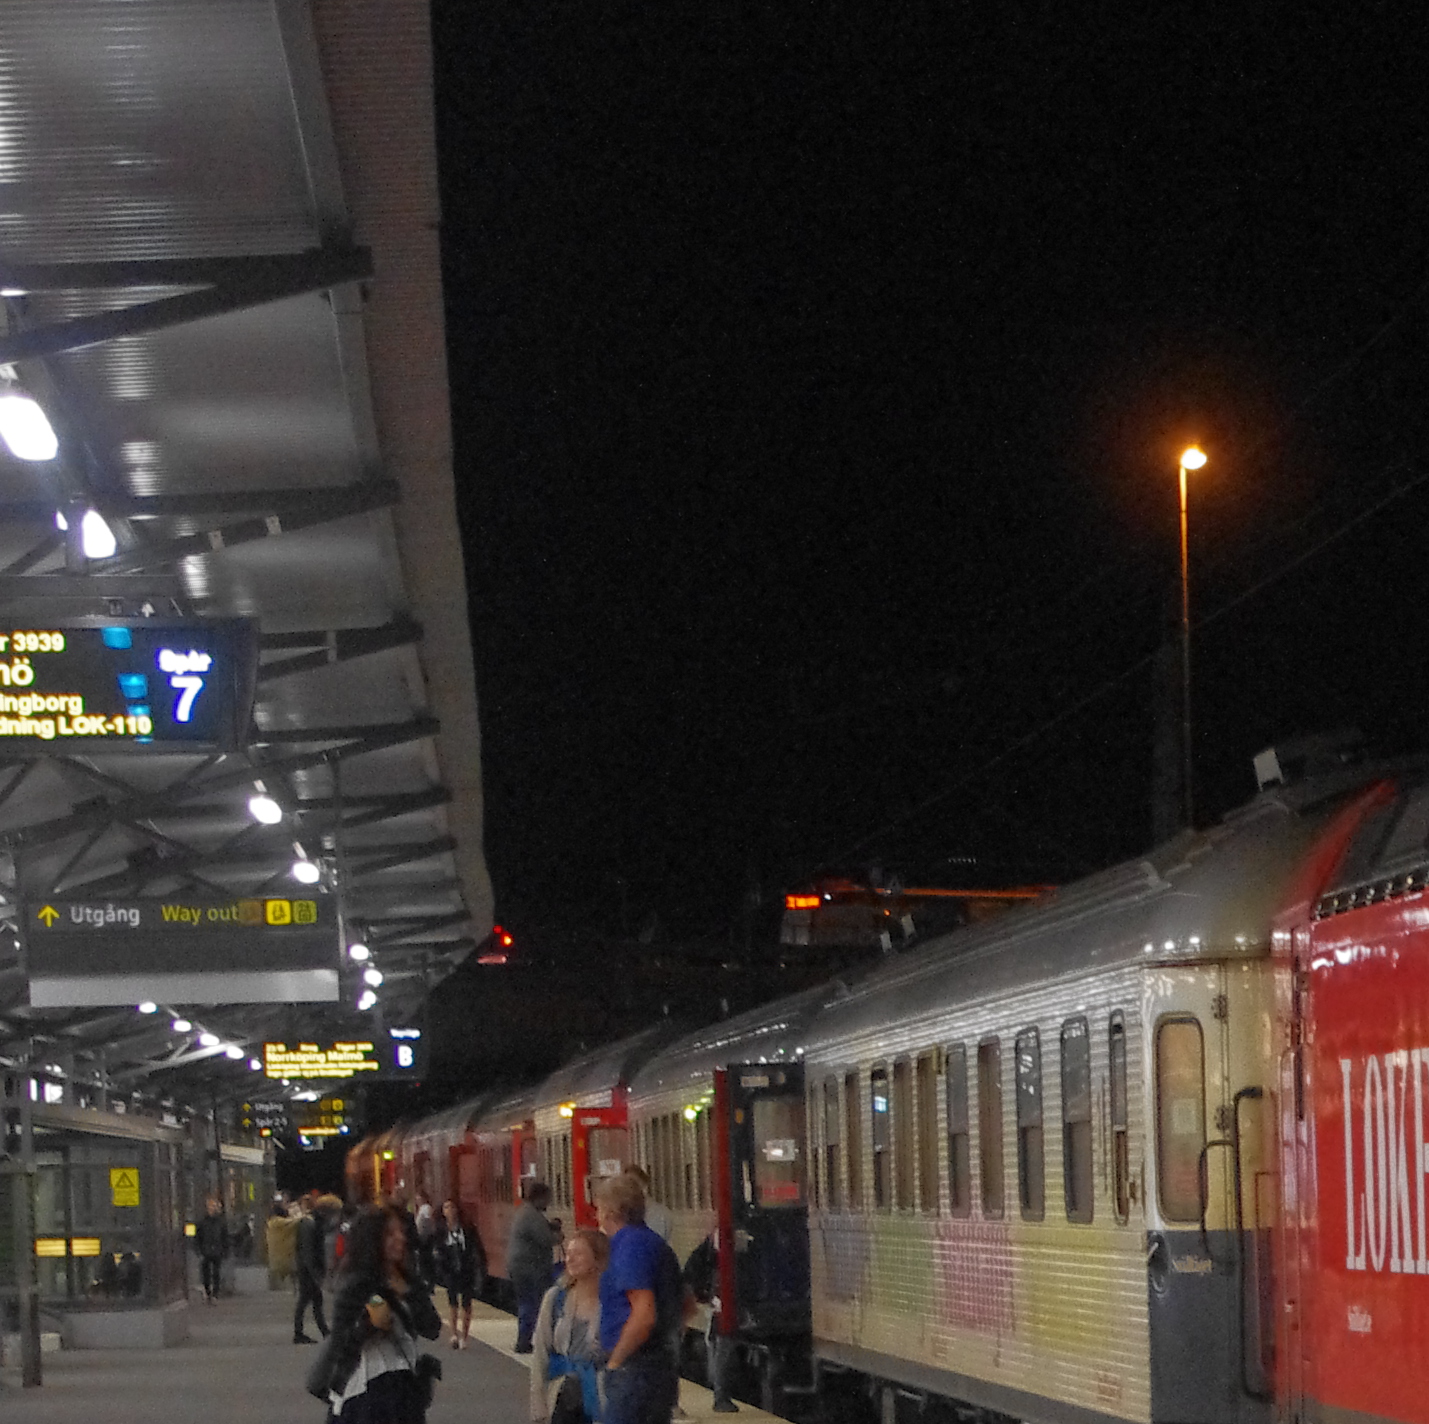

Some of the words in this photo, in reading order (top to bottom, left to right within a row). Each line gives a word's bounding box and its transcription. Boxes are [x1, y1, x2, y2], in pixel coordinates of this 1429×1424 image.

[12, 630, 66, 652] 3939
[168, 675, 205, 722] 7
[57, 714, 153, 735] LOK-110
[70, 904, 140, 927] Utgång
[162, 905, 201, 926] Way
[207, 906, 238, 921] out
[265, 1051, 326, 1063] Norrköping
[398, 1045, 413, 1068] B
